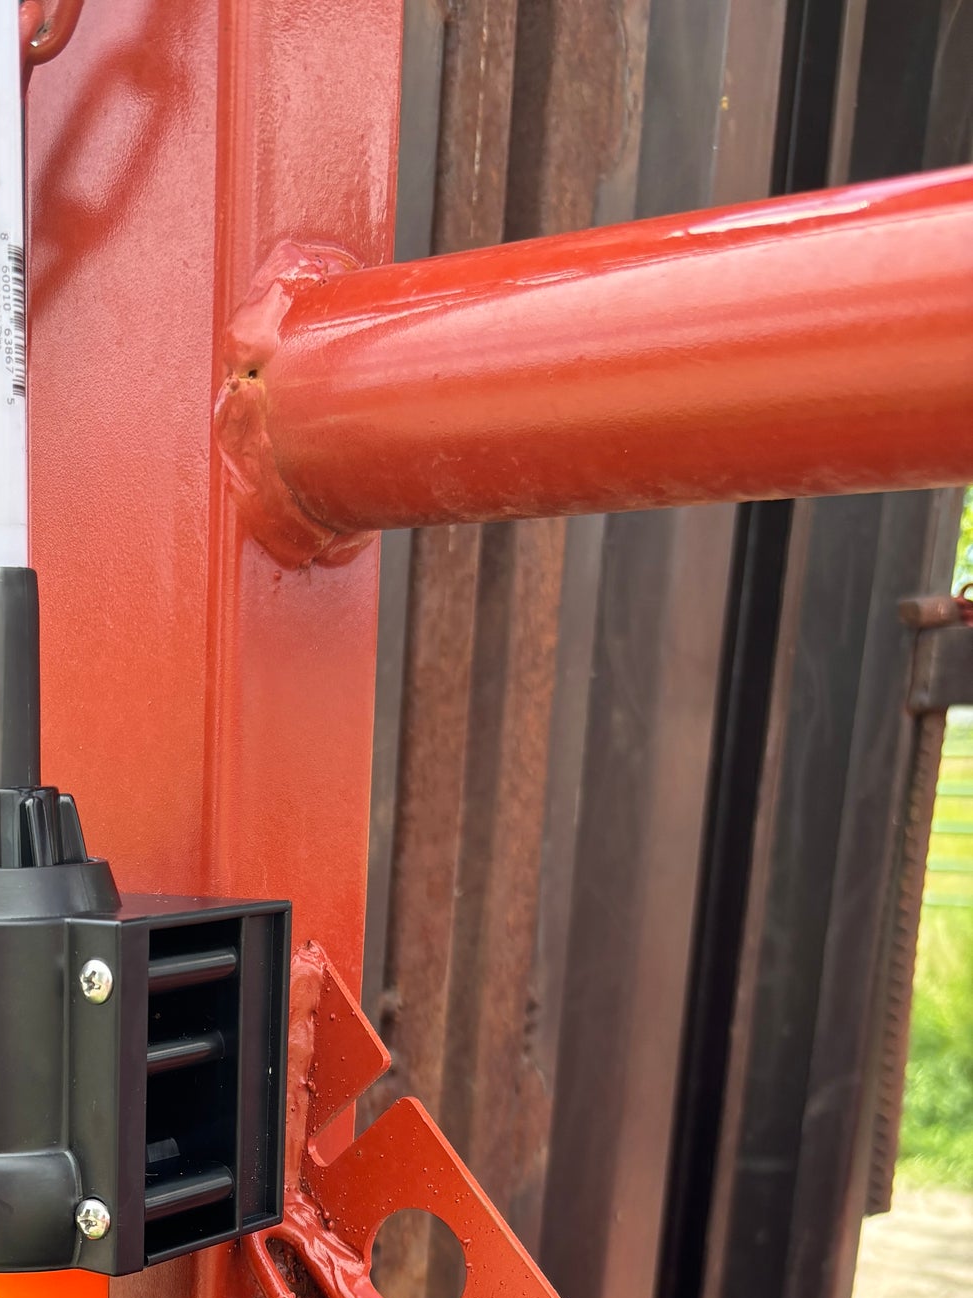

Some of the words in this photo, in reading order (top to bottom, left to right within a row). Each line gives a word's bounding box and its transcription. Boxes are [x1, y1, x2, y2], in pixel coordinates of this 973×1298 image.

[0, 232, 9, 241] 8
[1, 265, 12, 312] 60010
[4, 328, 14, 374] 63867
[6, 397, 15, 405] 5
